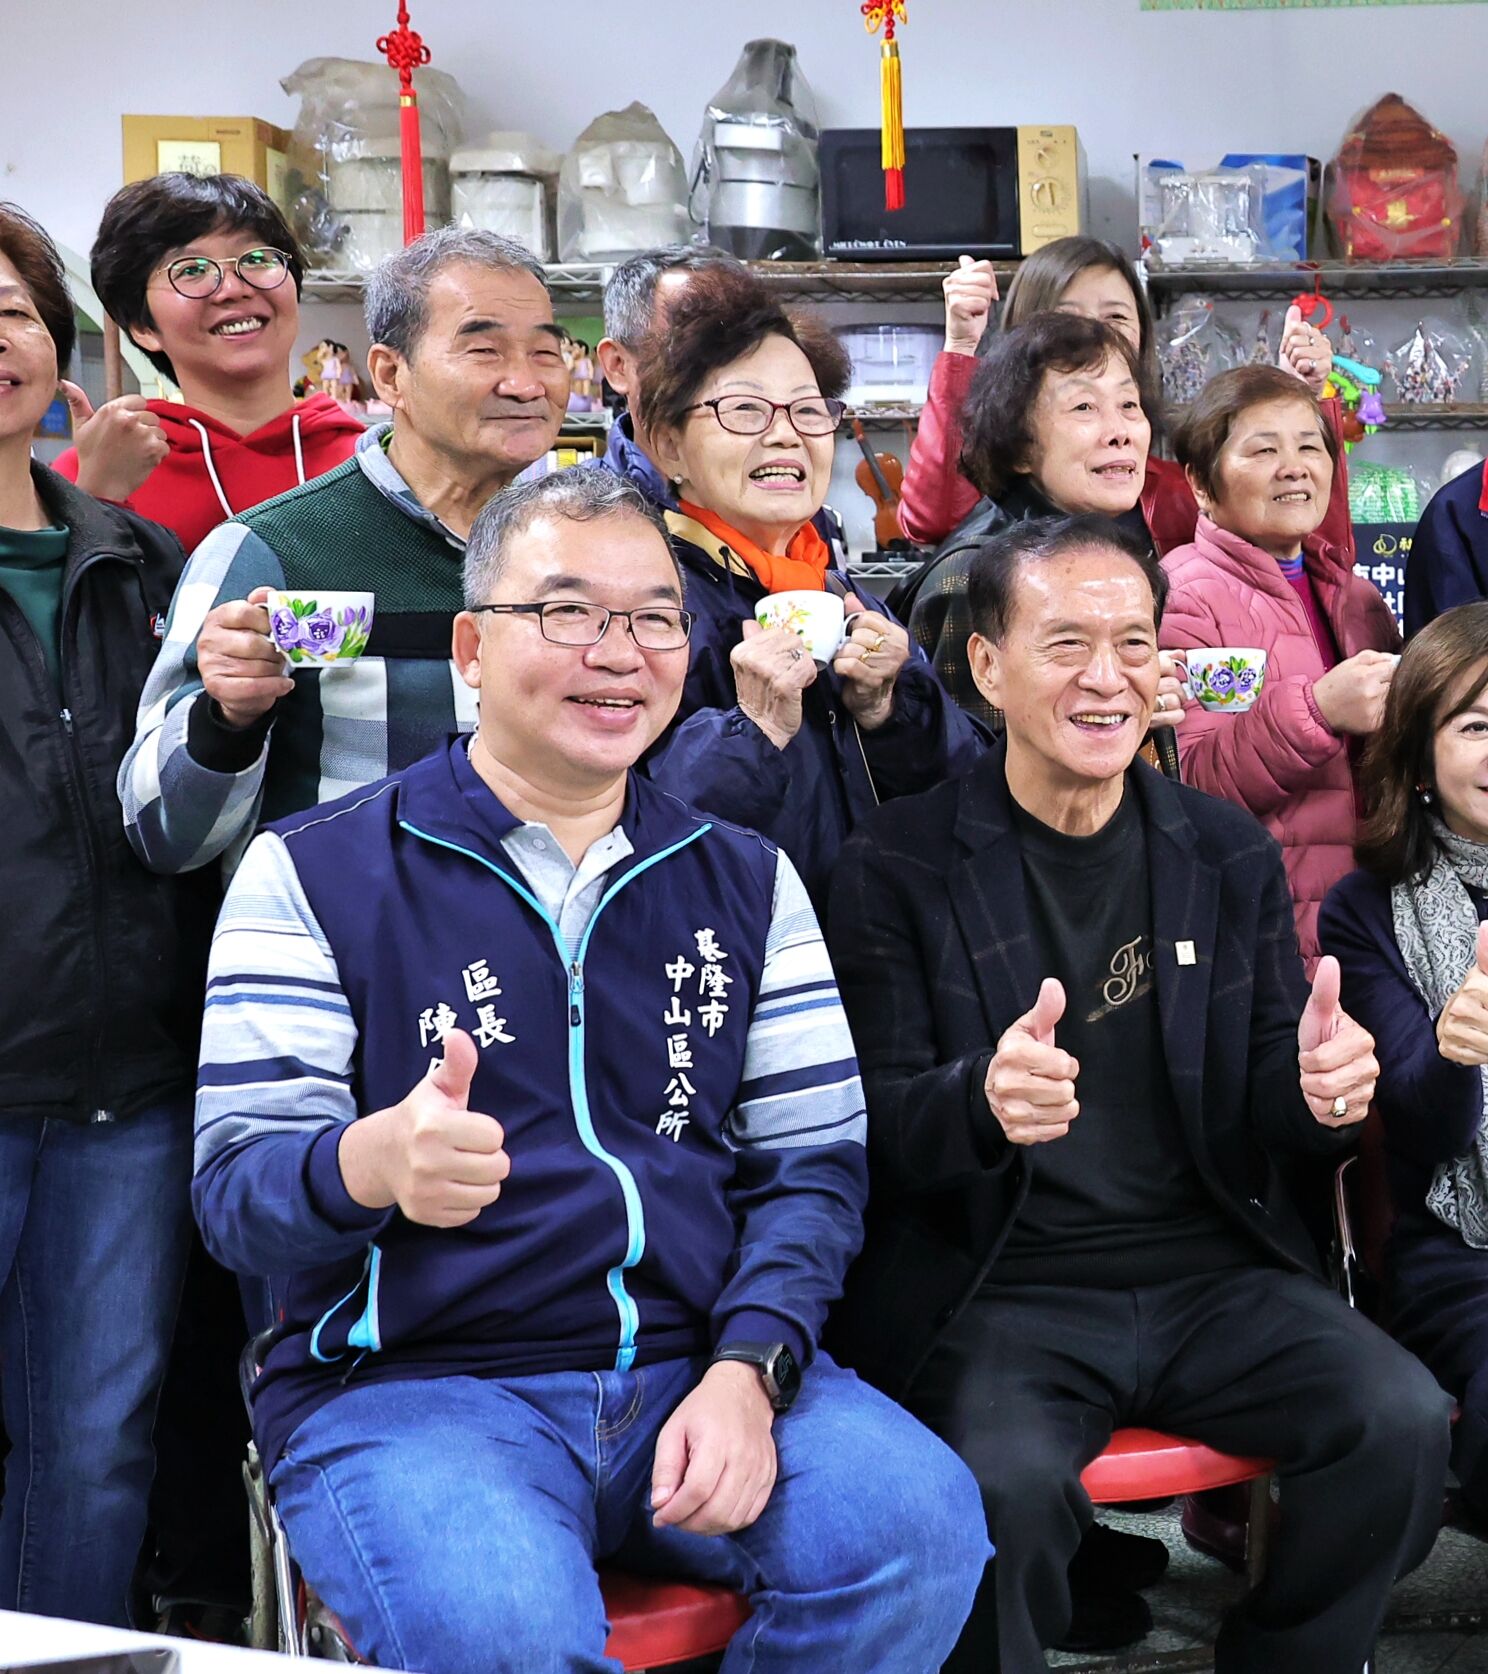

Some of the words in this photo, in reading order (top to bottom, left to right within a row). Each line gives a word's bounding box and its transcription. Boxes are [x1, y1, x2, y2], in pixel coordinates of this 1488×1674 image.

[461, 958, 516, 1049] 區長
[694, 928, 734, 1038] 基隆市
[418, 1002, 458, 1070] 陳
[656, 955, 697, 1143] 中山區公所
